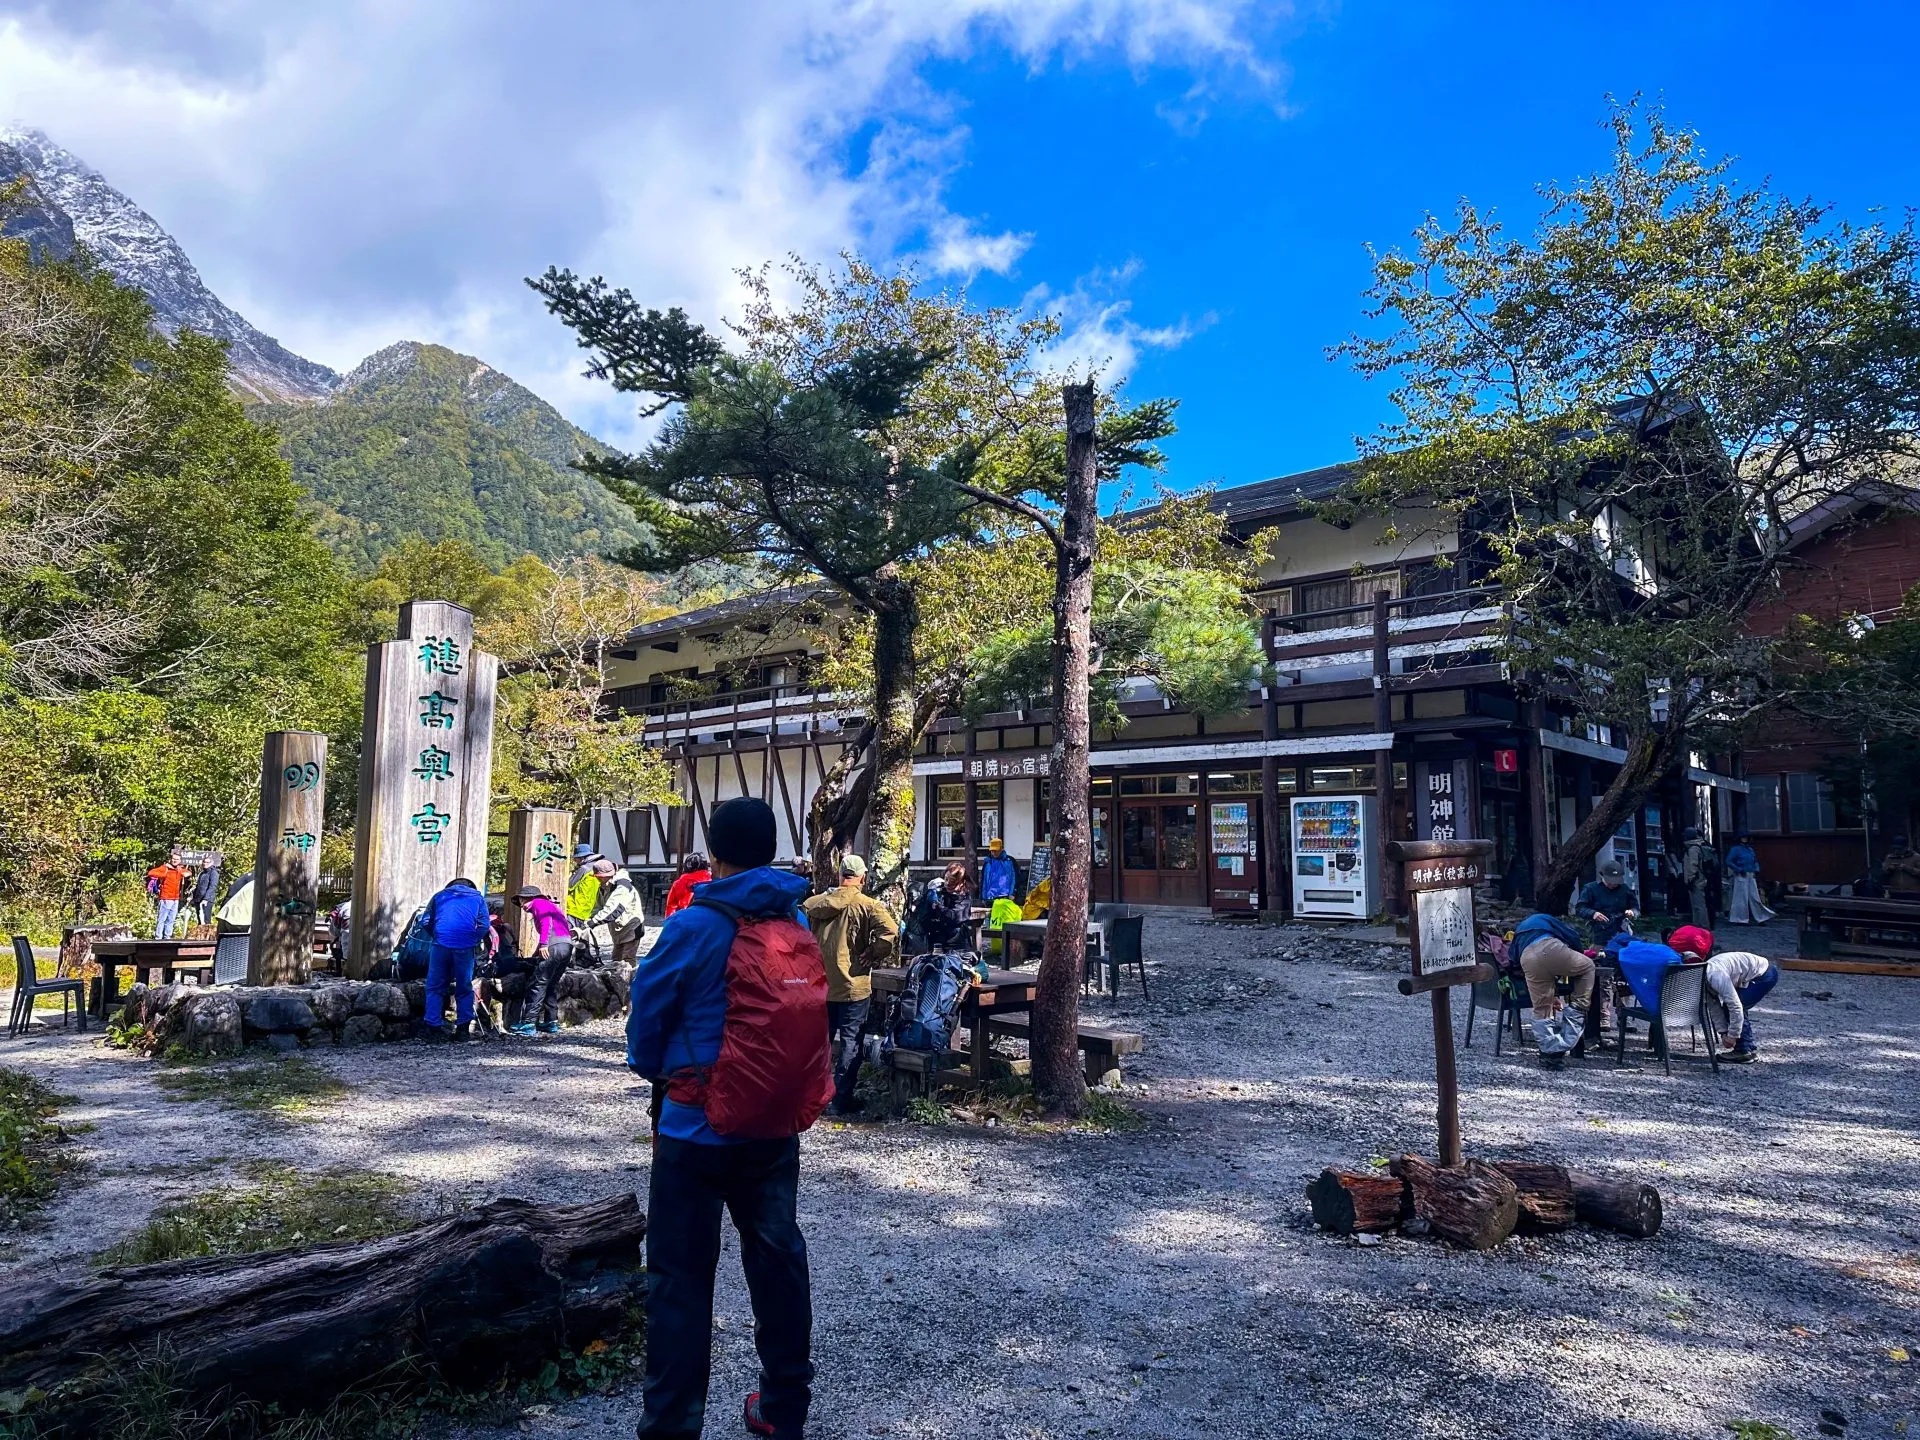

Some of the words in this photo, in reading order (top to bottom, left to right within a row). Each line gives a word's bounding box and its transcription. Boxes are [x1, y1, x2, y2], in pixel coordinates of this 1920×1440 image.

[970, 757, 1035, 777] 朝焼けの宿
[1428, 773, 1455, 840] 明神館
